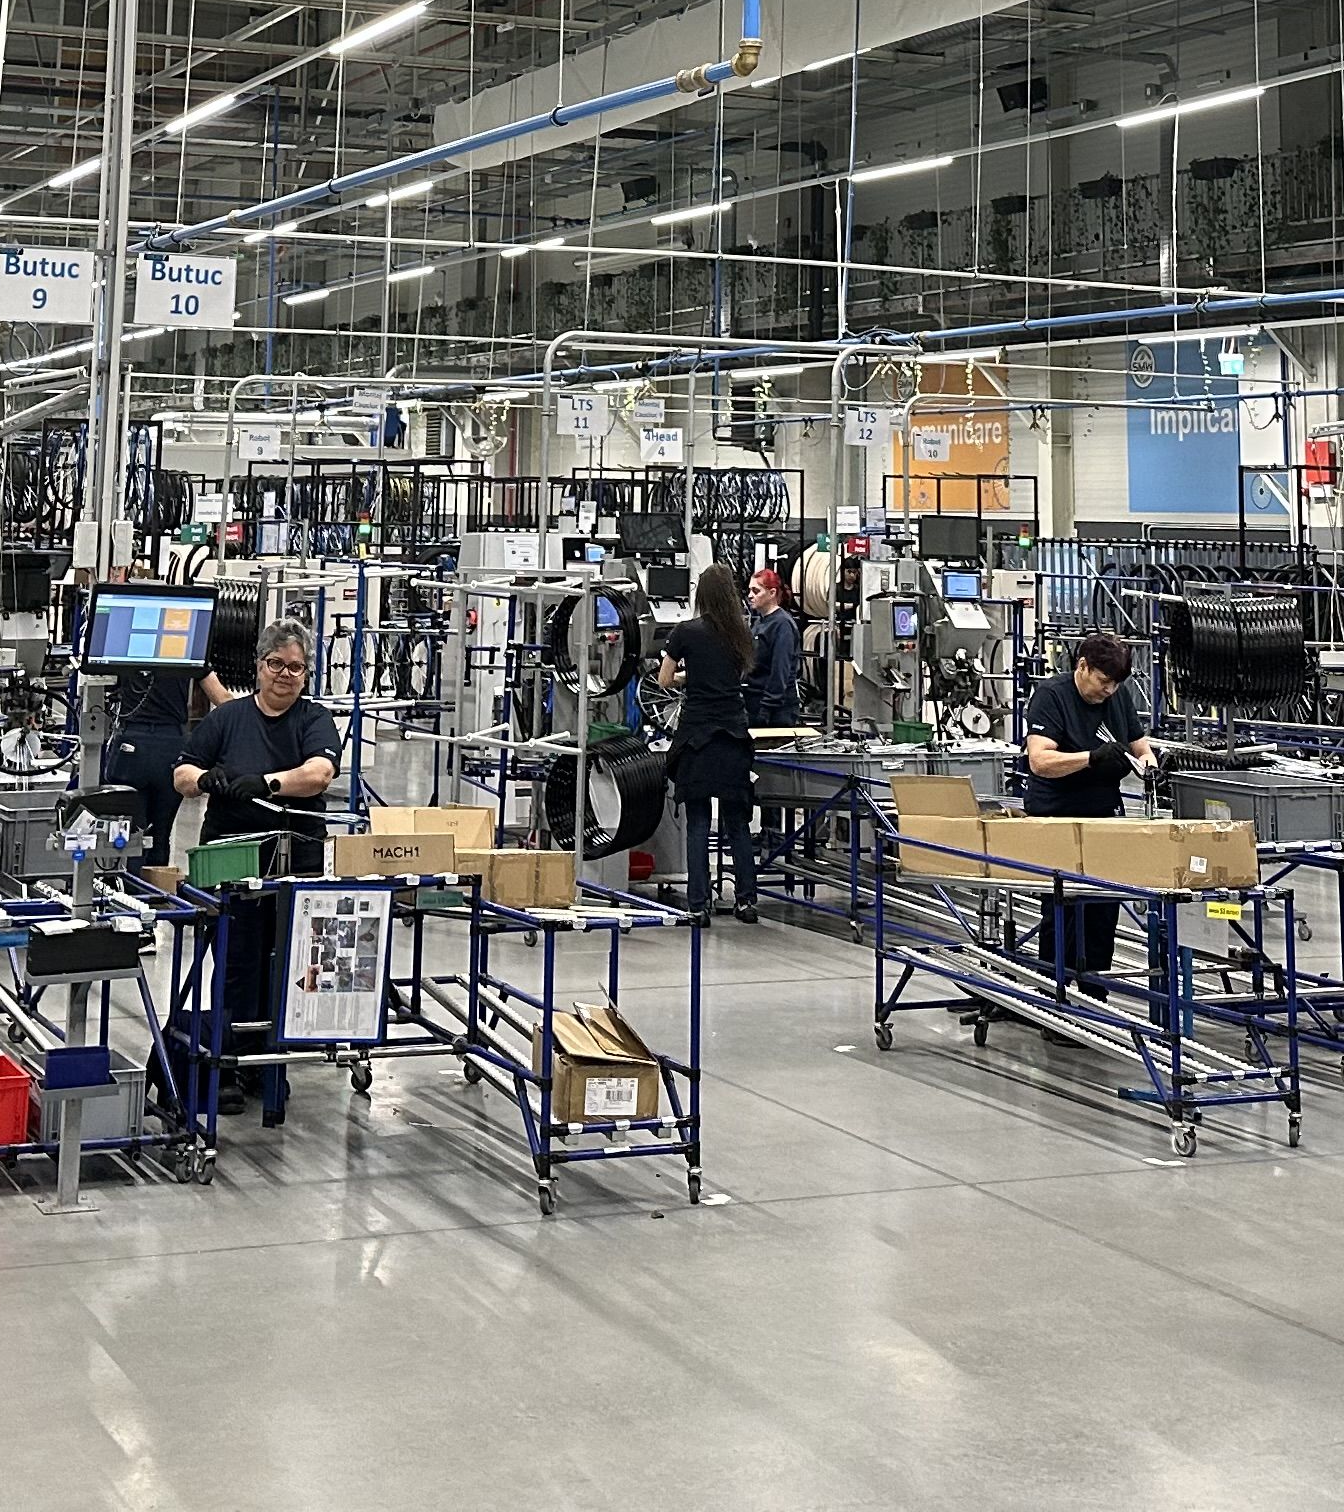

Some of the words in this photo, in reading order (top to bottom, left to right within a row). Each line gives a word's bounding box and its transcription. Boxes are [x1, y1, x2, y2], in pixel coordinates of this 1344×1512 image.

[5, 252, 80, 279] Butuc
[151, 260, 223, 285] Butuc
[32, 288, 48, 309] 9
[170, 293, 199, 316] 10
[572, 399, 593, 410] LTS
[574, 417, 589, 428] 11
[857, 412, 877, 423] LTS
[644, 431, 678, 442] 4Head
[859, 428, 873, 440] 12
[658, 447, 665, 456] 4
[373, 846, 420, 858] MACH1
